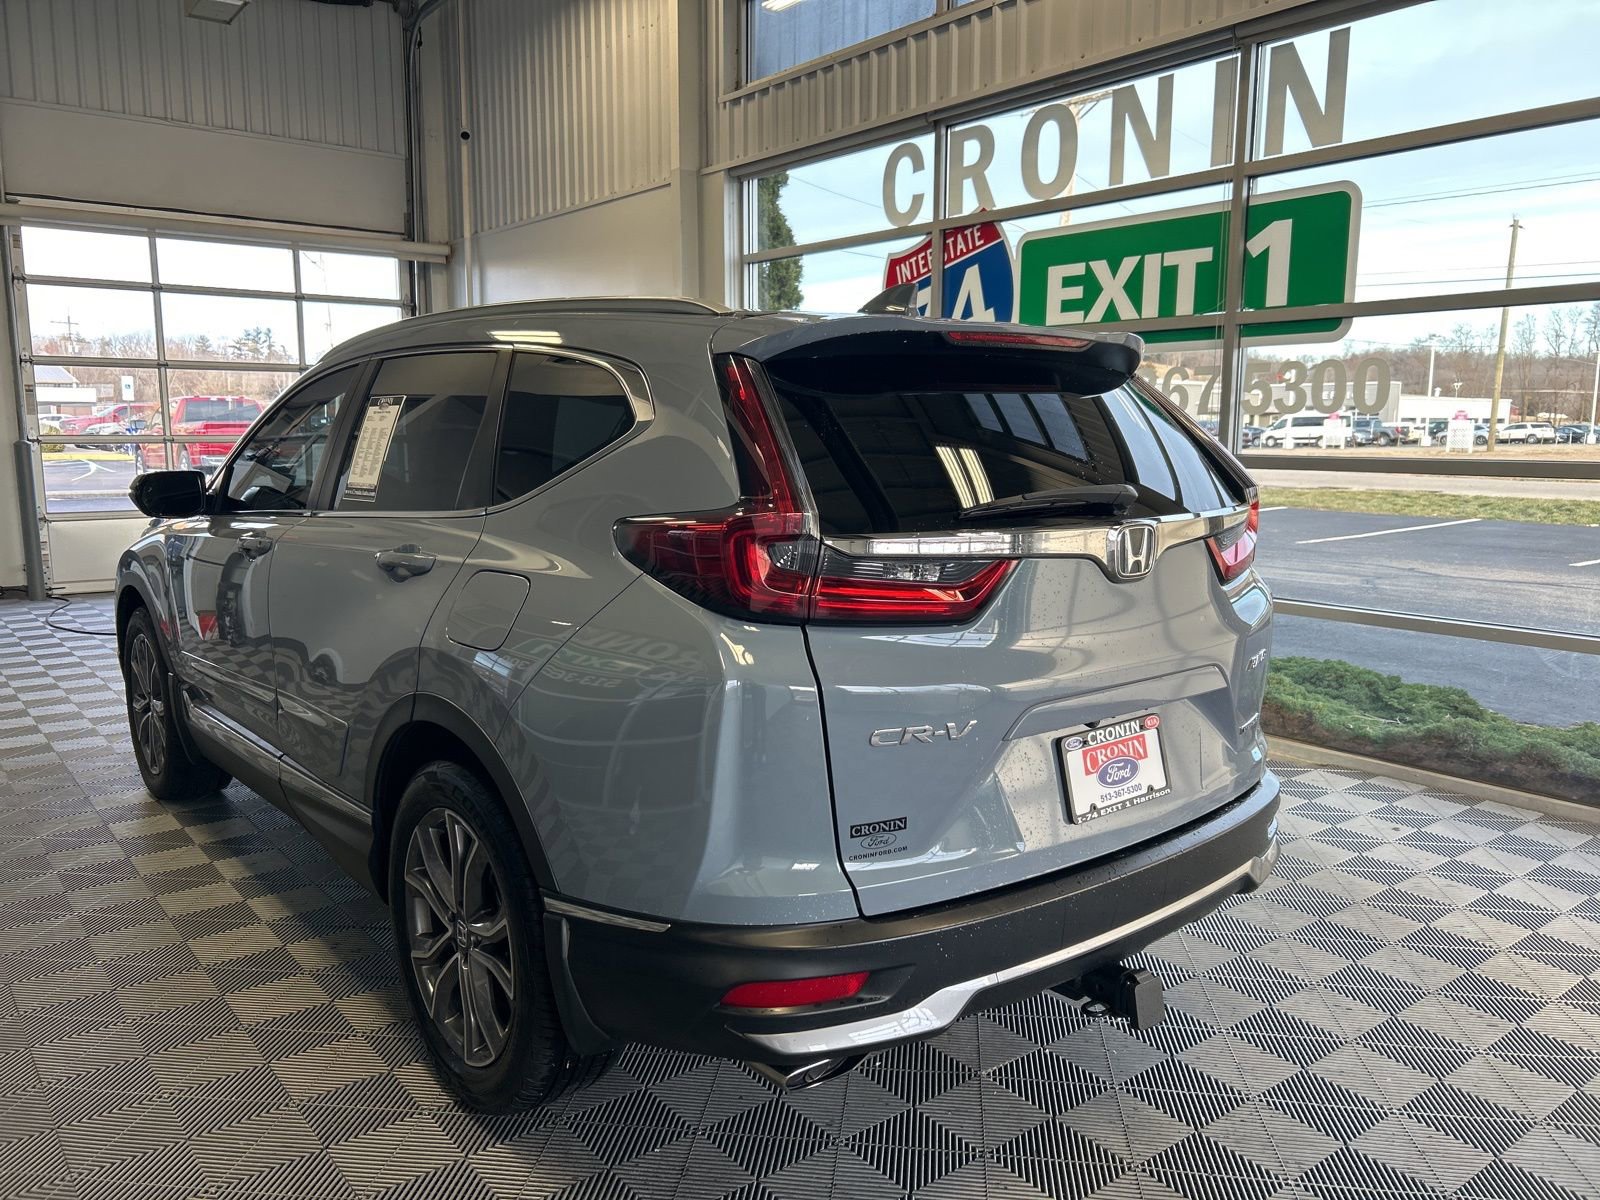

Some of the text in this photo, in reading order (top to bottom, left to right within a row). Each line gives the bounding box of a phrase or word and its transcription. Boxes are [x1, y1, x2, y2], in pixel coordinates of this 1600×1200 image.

[883, 27, 1350, 227] CRONIN
[896, 225, 985, 284] INTERTATE
[1046, 219, 1293, 326] EXIT 1
[869, 720, 977, 747] CR-V
[1088, 719, 1141, 745] CRONIN
[1085, 738, 1145, 773] CRONIN
[1106, 761, 1132, 782] Ford
[1077, 788, 1171, 824] I-74 EXIT 1 Harrison
[1100, 783, 1143, 803] 513-367-5300
[851, 818, 906, 837] CRONIN
[848, 846, 908, 862] CRONINFORD.COM
